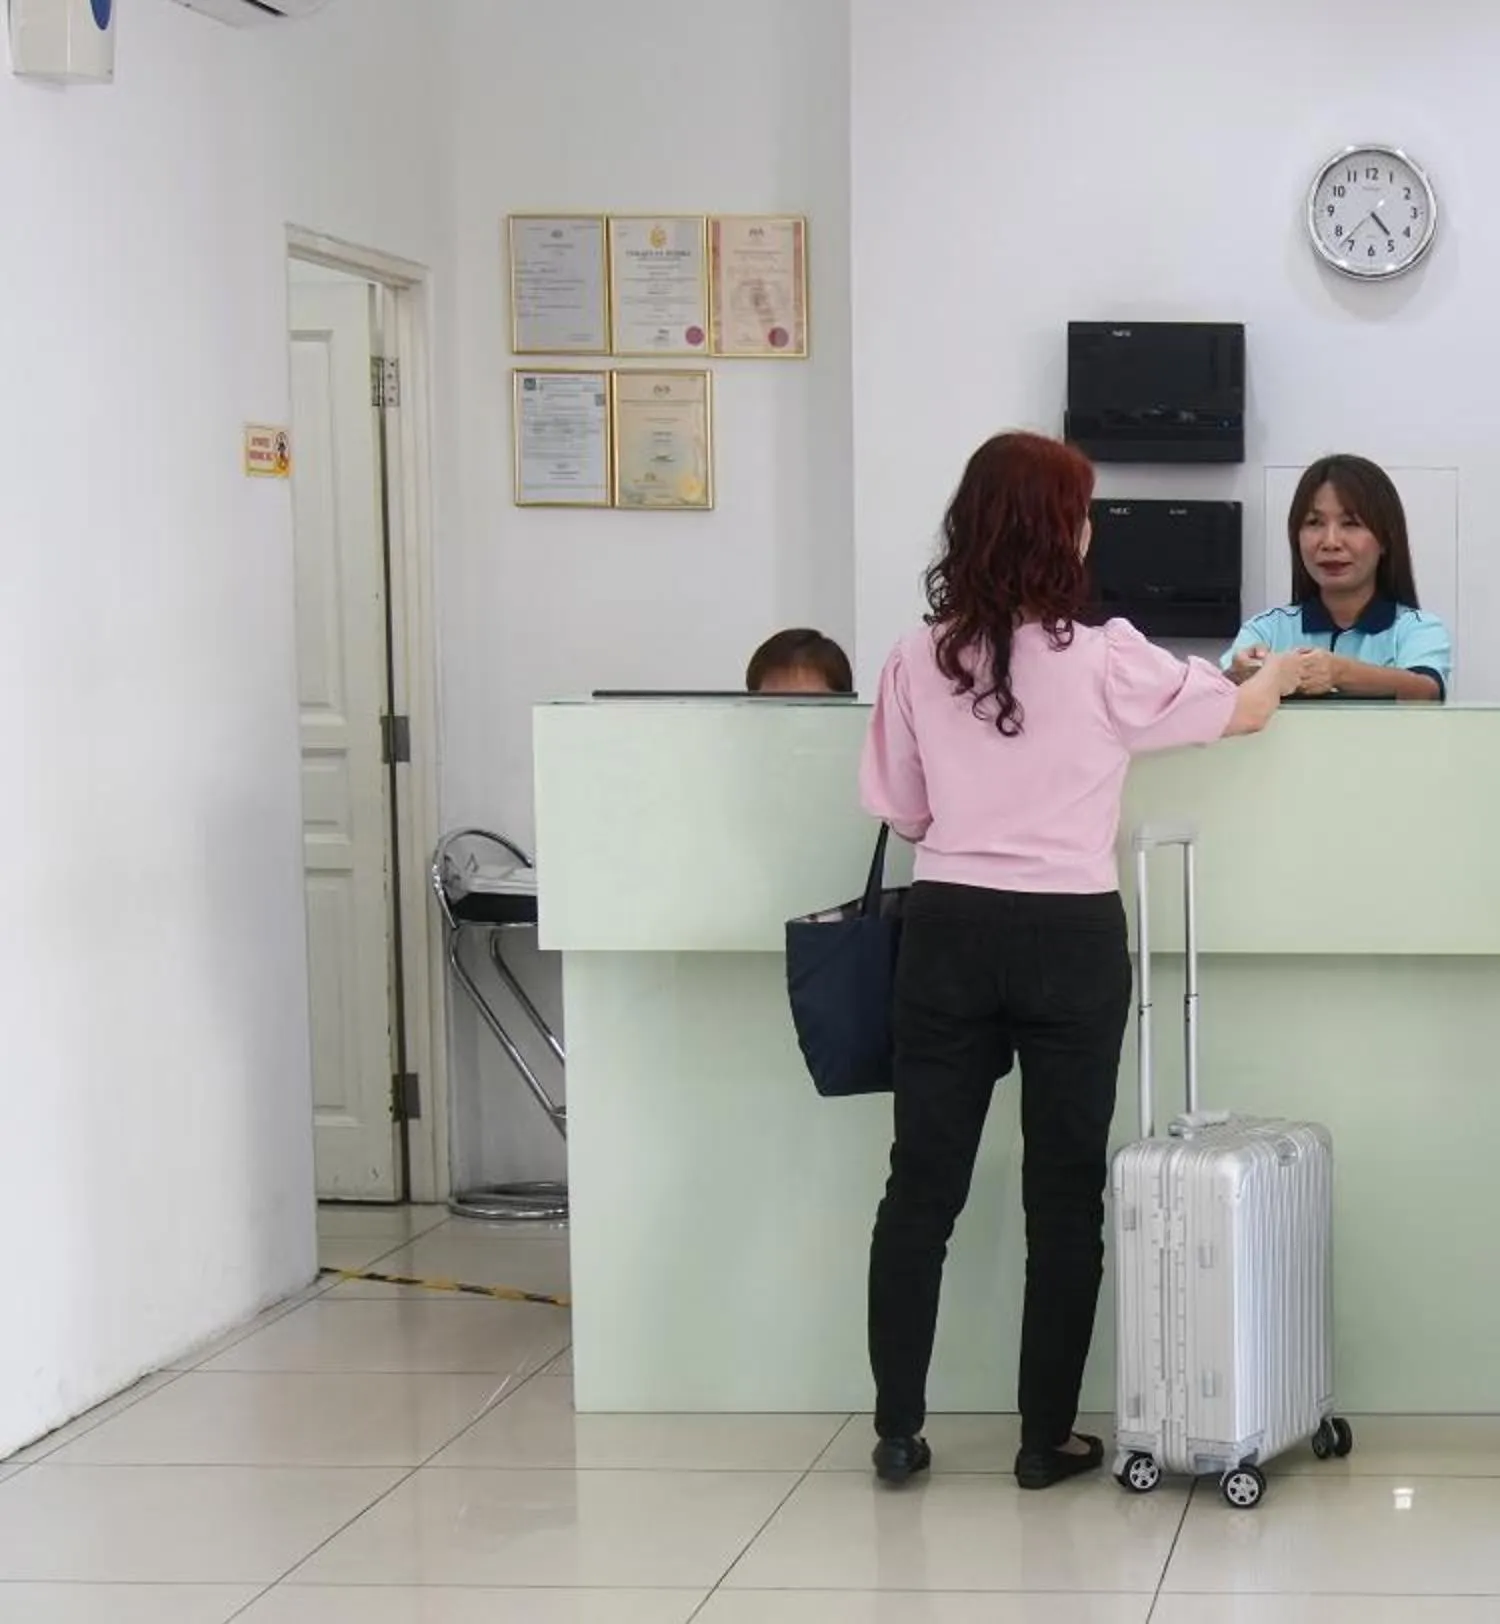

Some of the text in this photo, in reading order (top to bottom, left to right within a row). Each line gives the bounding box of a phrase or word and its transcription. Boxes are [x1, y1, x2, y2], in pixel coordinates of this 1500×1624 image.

[1347, 170, 1357, 182] 11
[1365, 167, 1379, 180] 12
[1389, 171, 1393, 183] 1
[1333, 185, 1345, 198] 10
[1403, 187, 1411, 200] 2
[1327, 204, 1335, 216] 9
[1410, 207, 1418, 219] 3
[1335, 224, 1343, 237] 8
[1402, 226, 1411, 238] 4
[1347, 239, 1355, 252] 7
[1367, 245, 1376, 257] 6
[1387, 240, 1395, 252] 5
